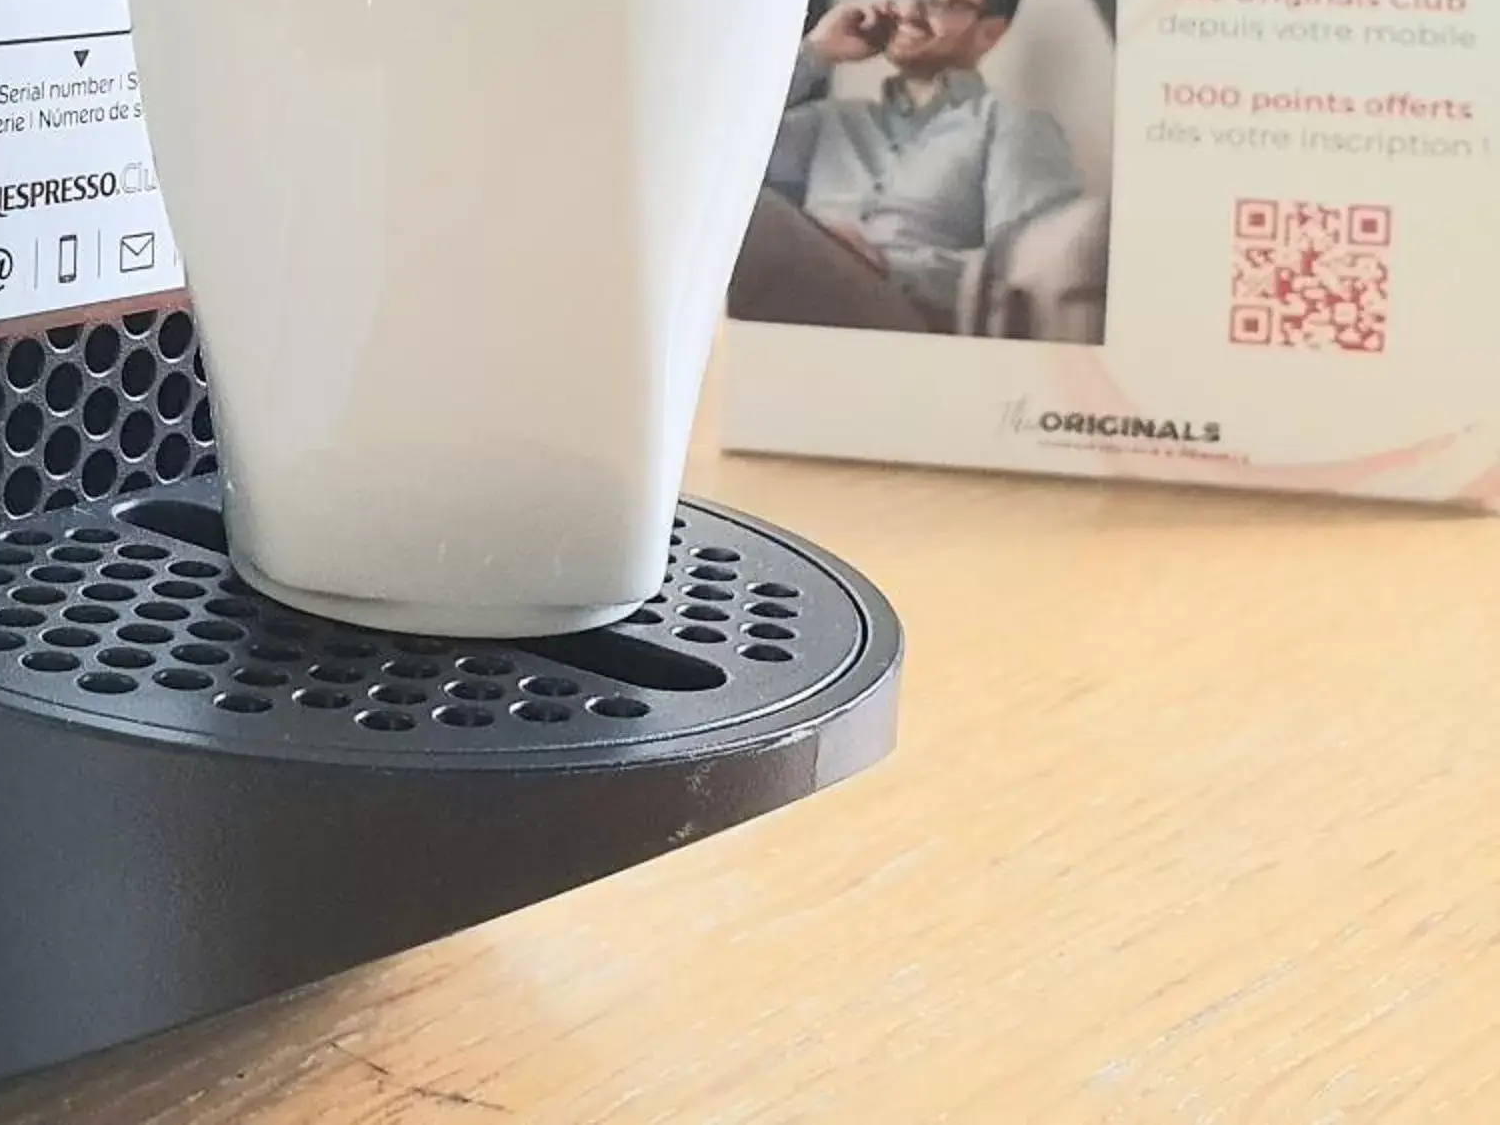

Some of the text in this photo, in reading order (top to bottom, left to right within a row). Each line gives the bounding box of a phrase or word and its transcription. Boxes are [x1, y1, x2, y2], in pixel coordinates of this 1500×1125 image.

[1157, 13, 1478, 51] depuis votre mobile
[49, 76, 115, 100] number
[1160, 81, 1475, 121] 1000 points offerts
[38, 104, 106, 130] Número
[109, 100, 129, 121] de
[1210, 124, 1292, 149] votre
[1301, 128, 1475, 161] inscription
[1038, 411, 1222, 443] ORIGINALS
